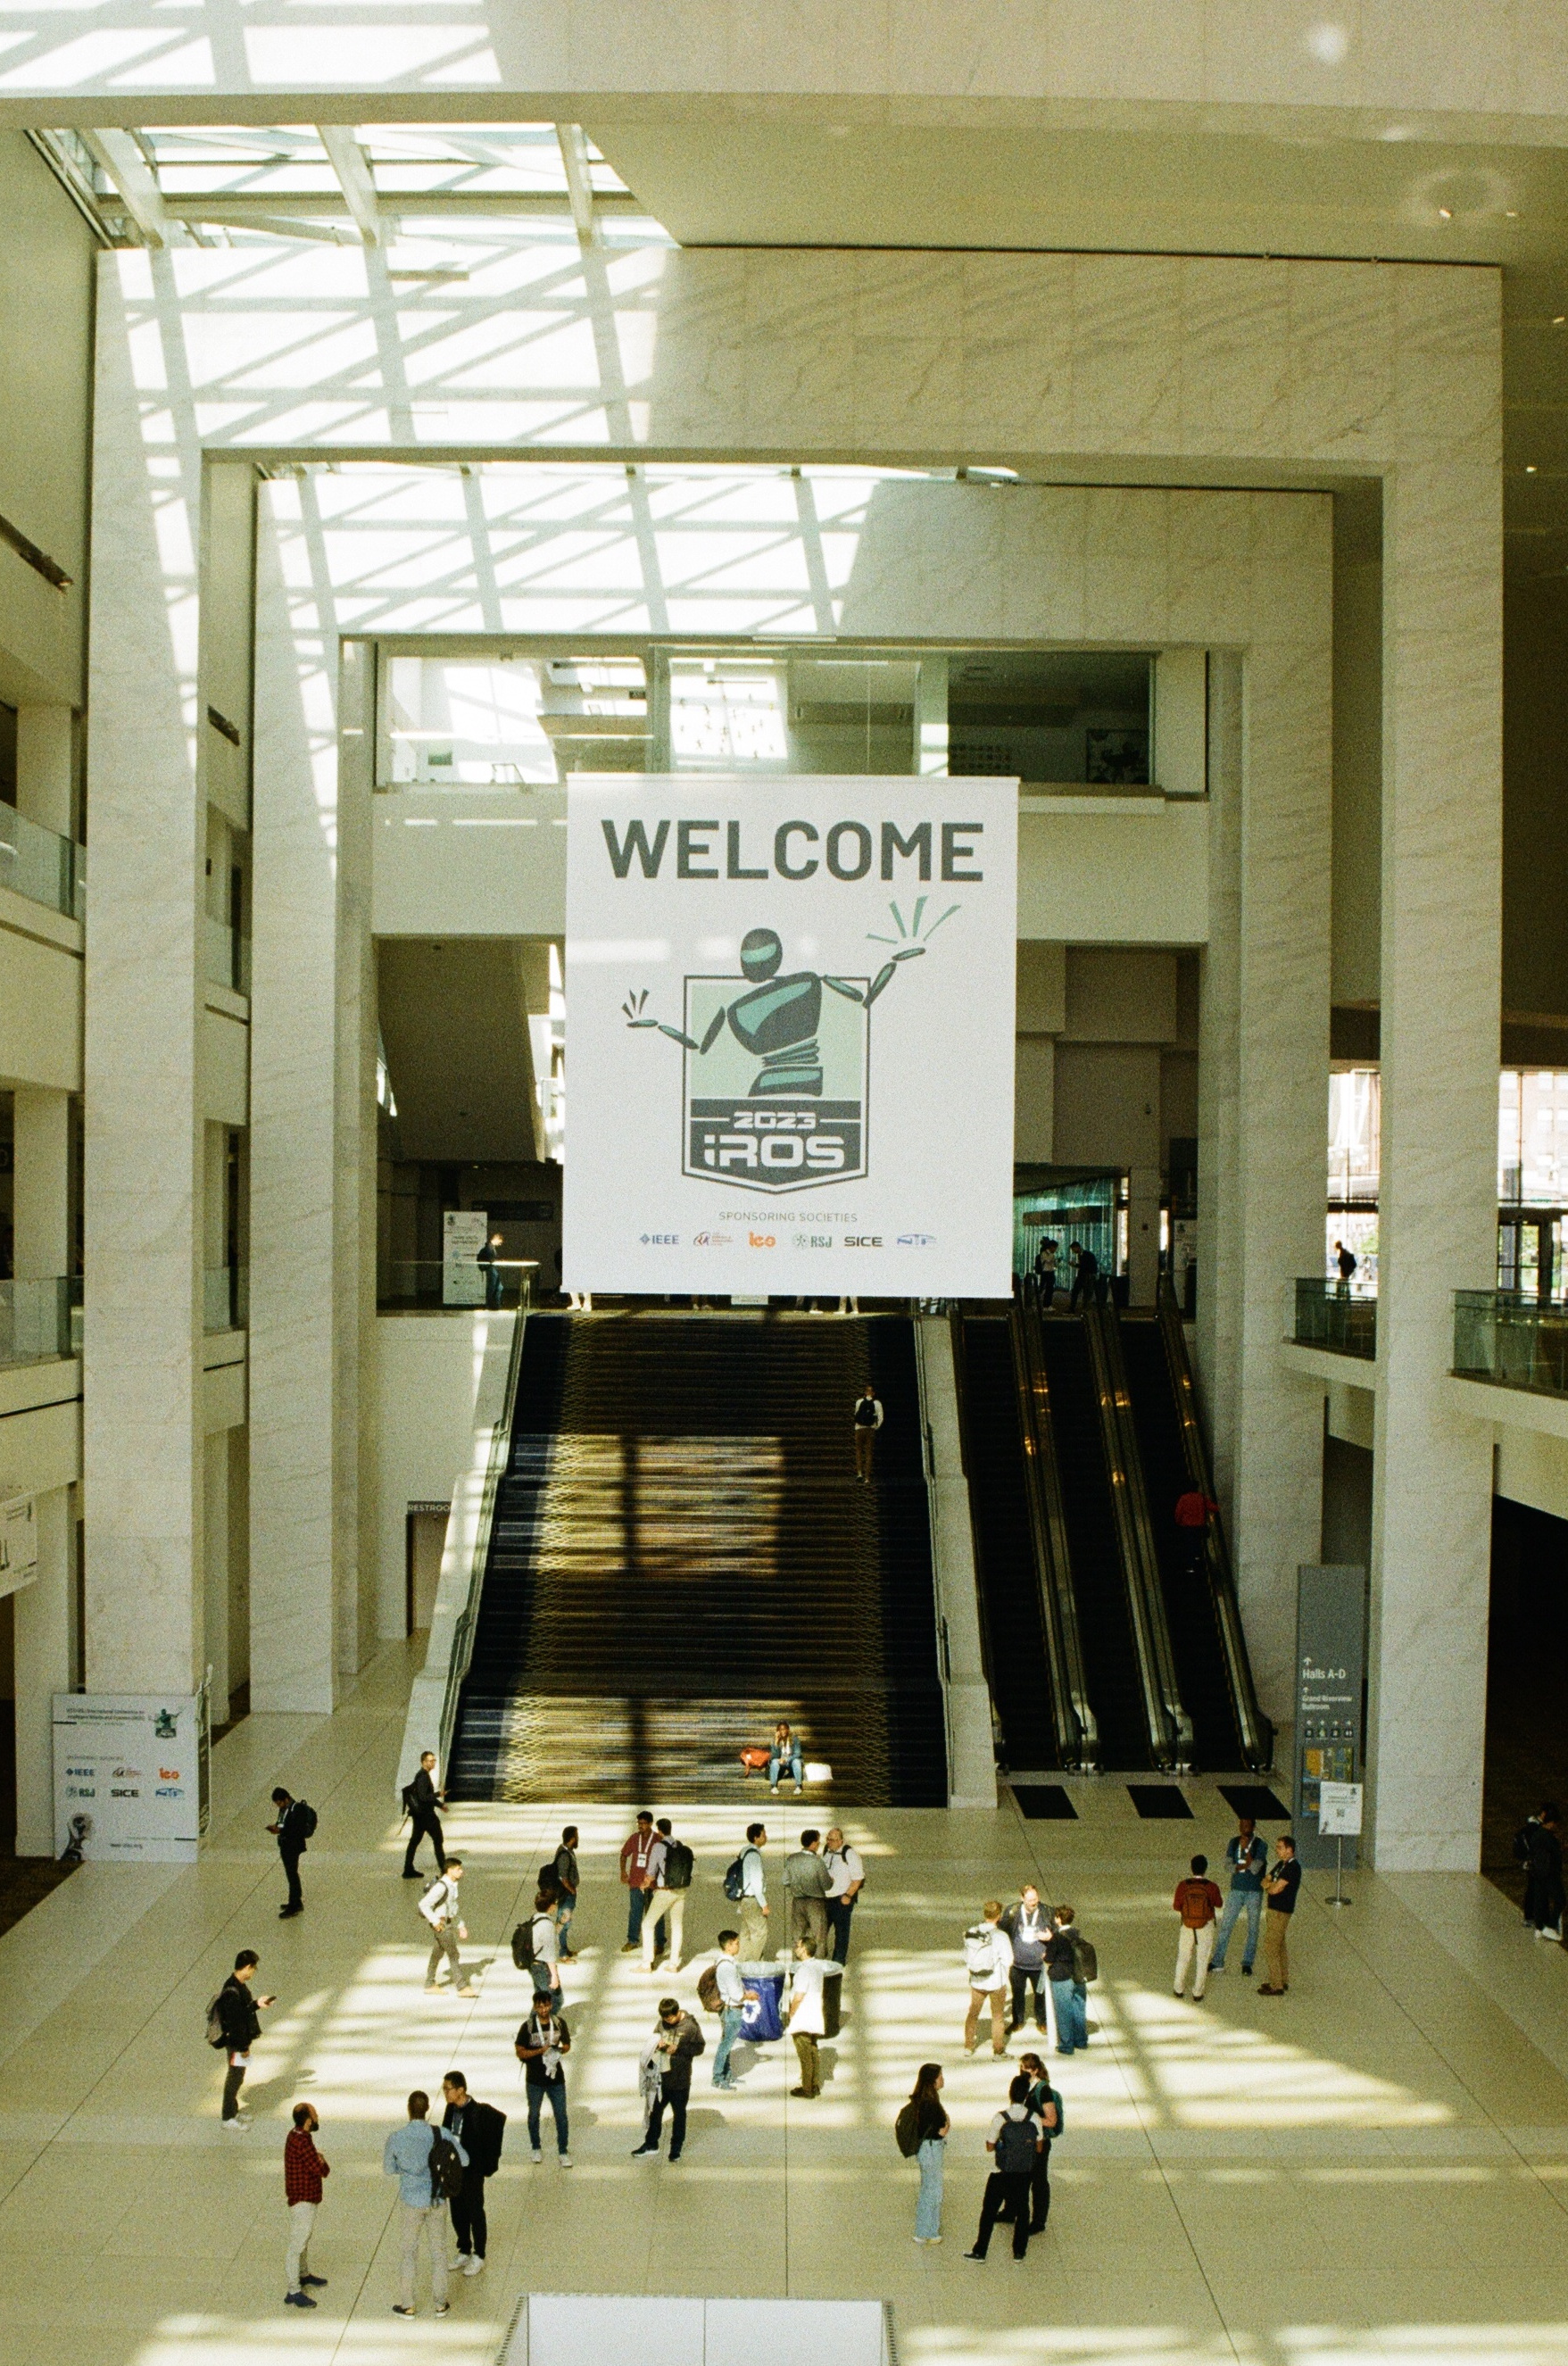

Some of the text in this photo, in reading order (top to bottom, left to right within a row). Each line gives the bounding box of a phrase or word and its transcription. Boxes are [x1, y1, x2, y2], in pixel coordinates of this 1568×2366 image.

[601, 819, 984, 883] WELCOME
[733, 1110, 817, 1129] 2023
[718, 1211, 858, 1223] SPONSORING SOCIETIES
[651, 1234, 679, 1245] IEEE
[810, 1235, 833, 1248] RSJ
[843, 1235, 883, 1247] SICE
[408, 1504, 451, 1512] RESTROO
[1303, 1668, 1347, 1679] Halls A-D
[74, 1768, 95, 1776] IEEE
[111, 1789, 140, 1797] SICE
